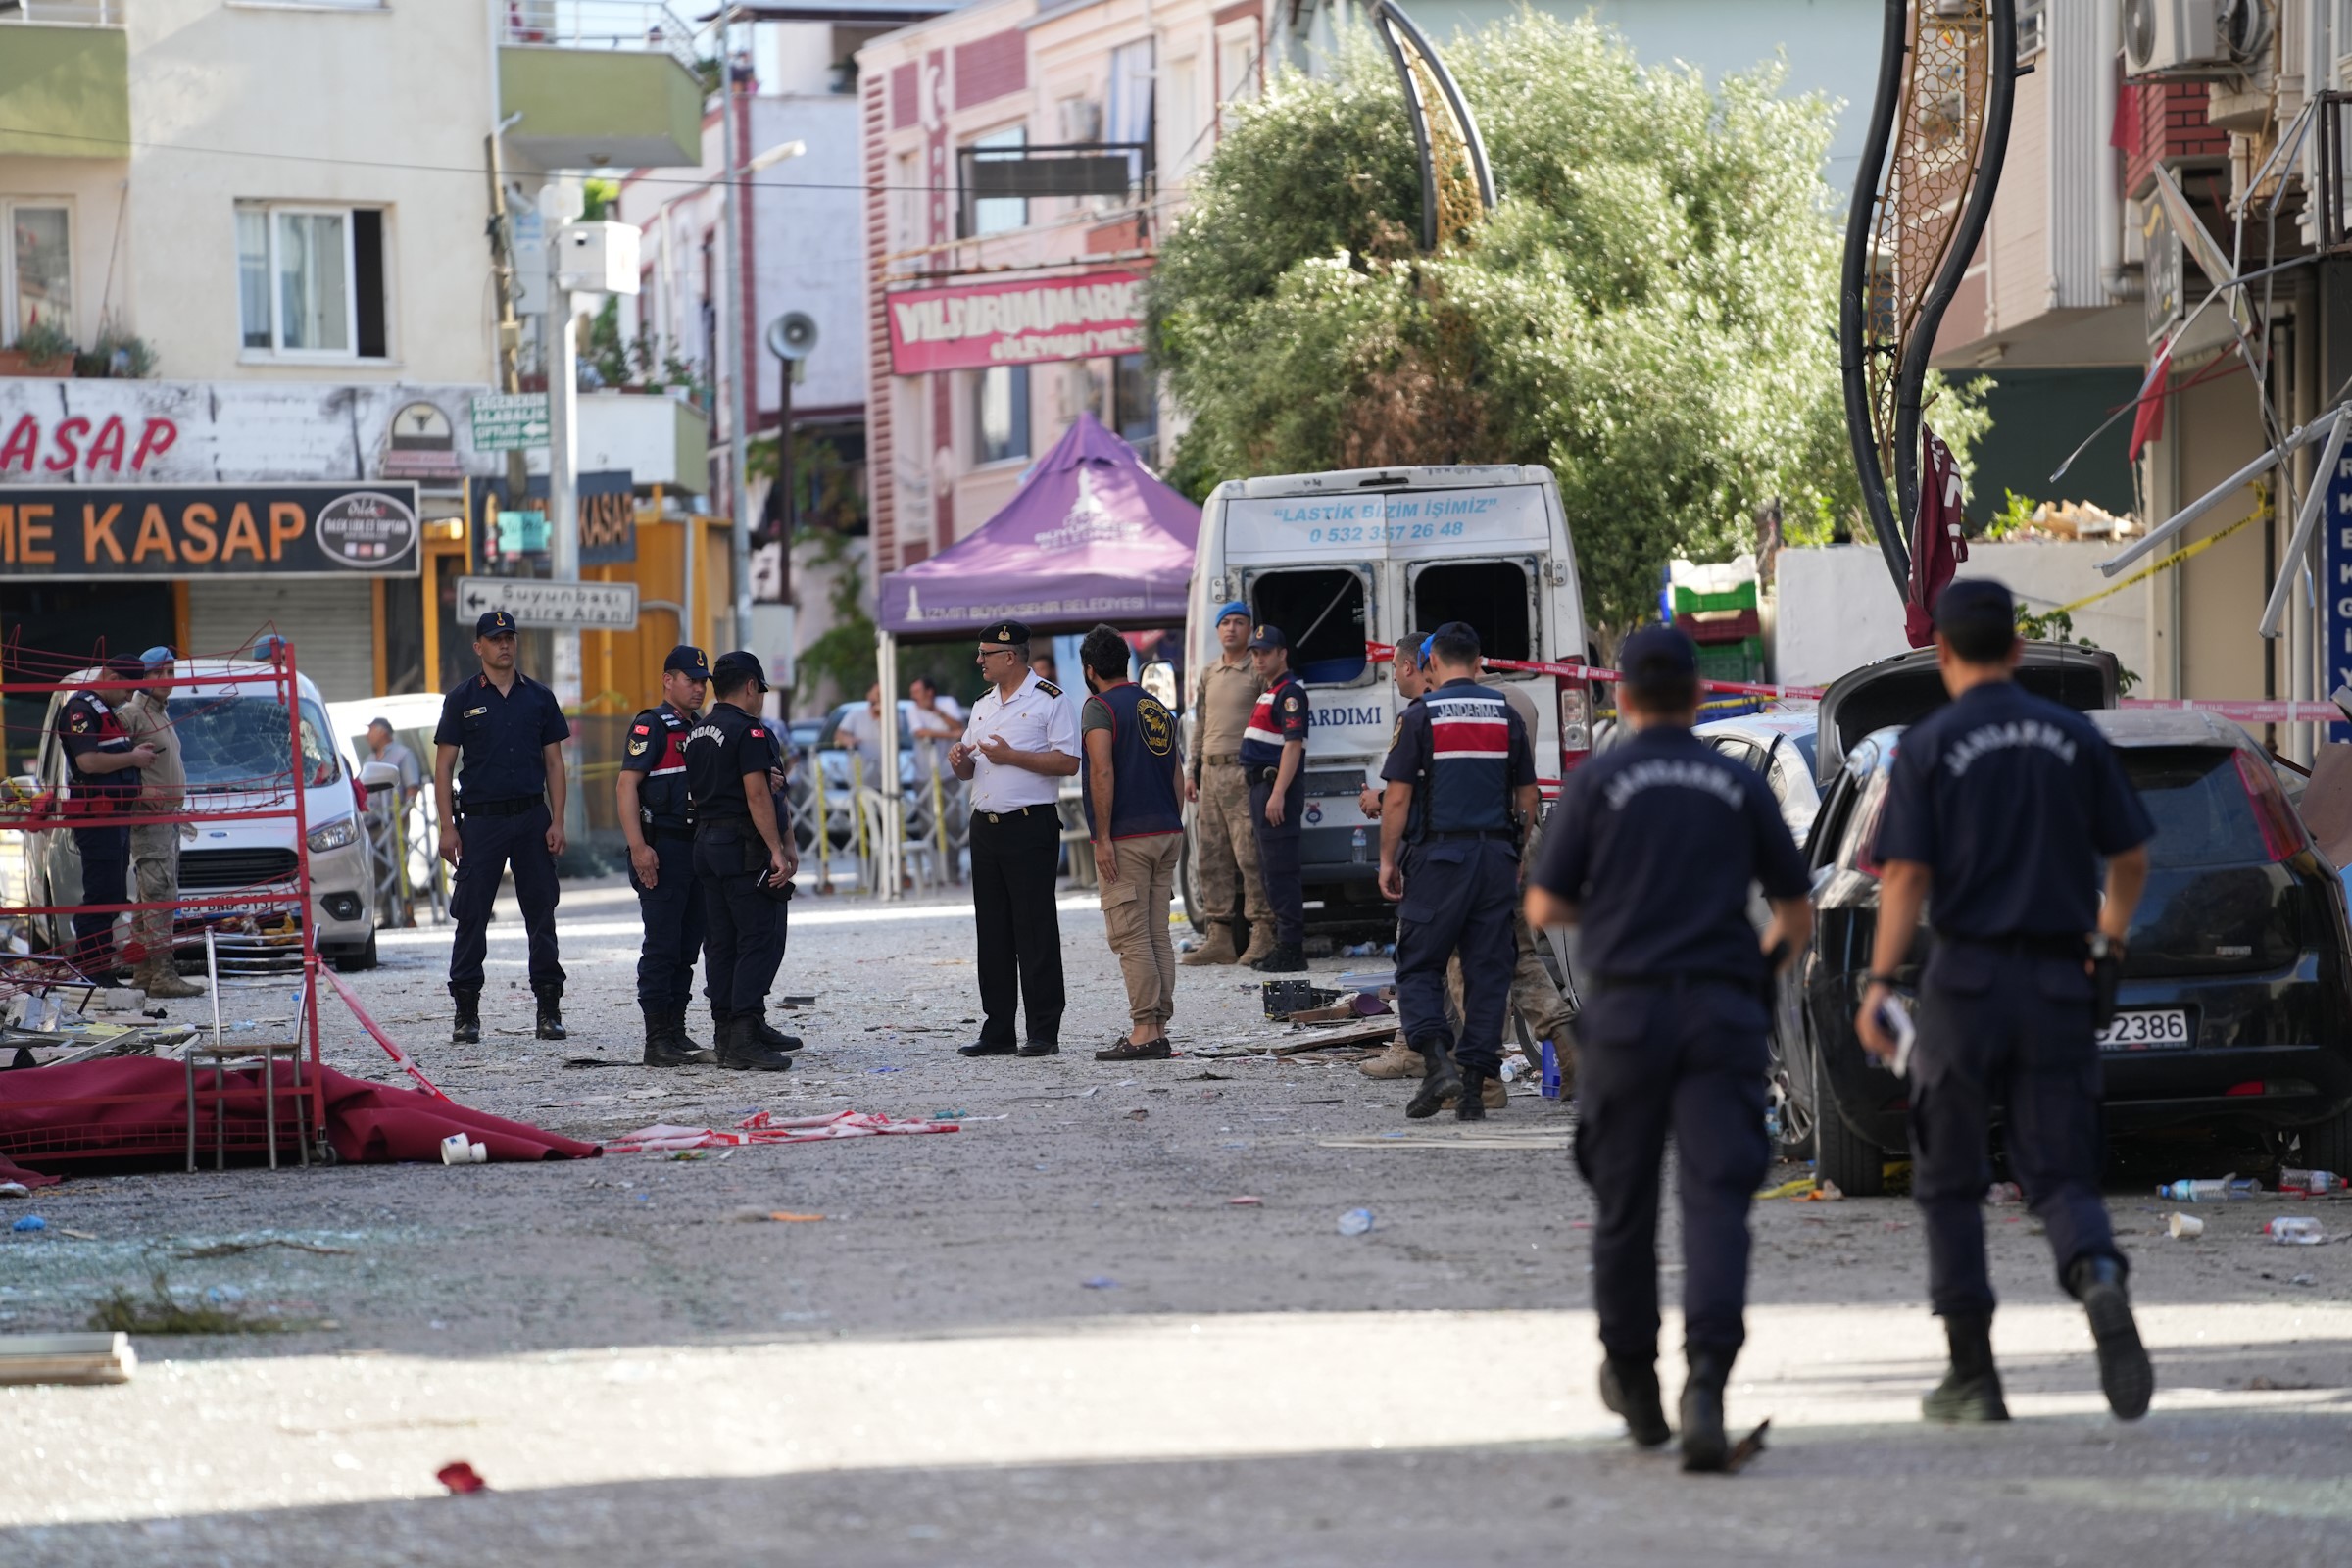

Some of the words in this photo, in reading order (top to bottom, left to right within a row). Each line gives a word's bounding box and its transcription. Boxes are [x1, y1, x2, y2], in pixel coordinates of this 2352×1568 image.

[1361, 500, 1418, 519] BİZİM
[83, 502, 306, 564] KASAP
[1309, 529, 1322, 543] 0
[1327, 526, 1363, 543] 532
[1369, 525, 1406, 541] 357
[1410, 522, 1434, 539] 26
[1440, 520, 1464, 537] 48
[502, 584, 620, 605] Suyunbaşı
[572, 607, 631, 625] Alanı
[1437, 703, 1500, 718] JANDARMA
[682, 725, 725, 753] JANDARMA
[1943, 718, 2077, 778] JANDARMA
[1602, 758, 1745, 812] JANDARMA
